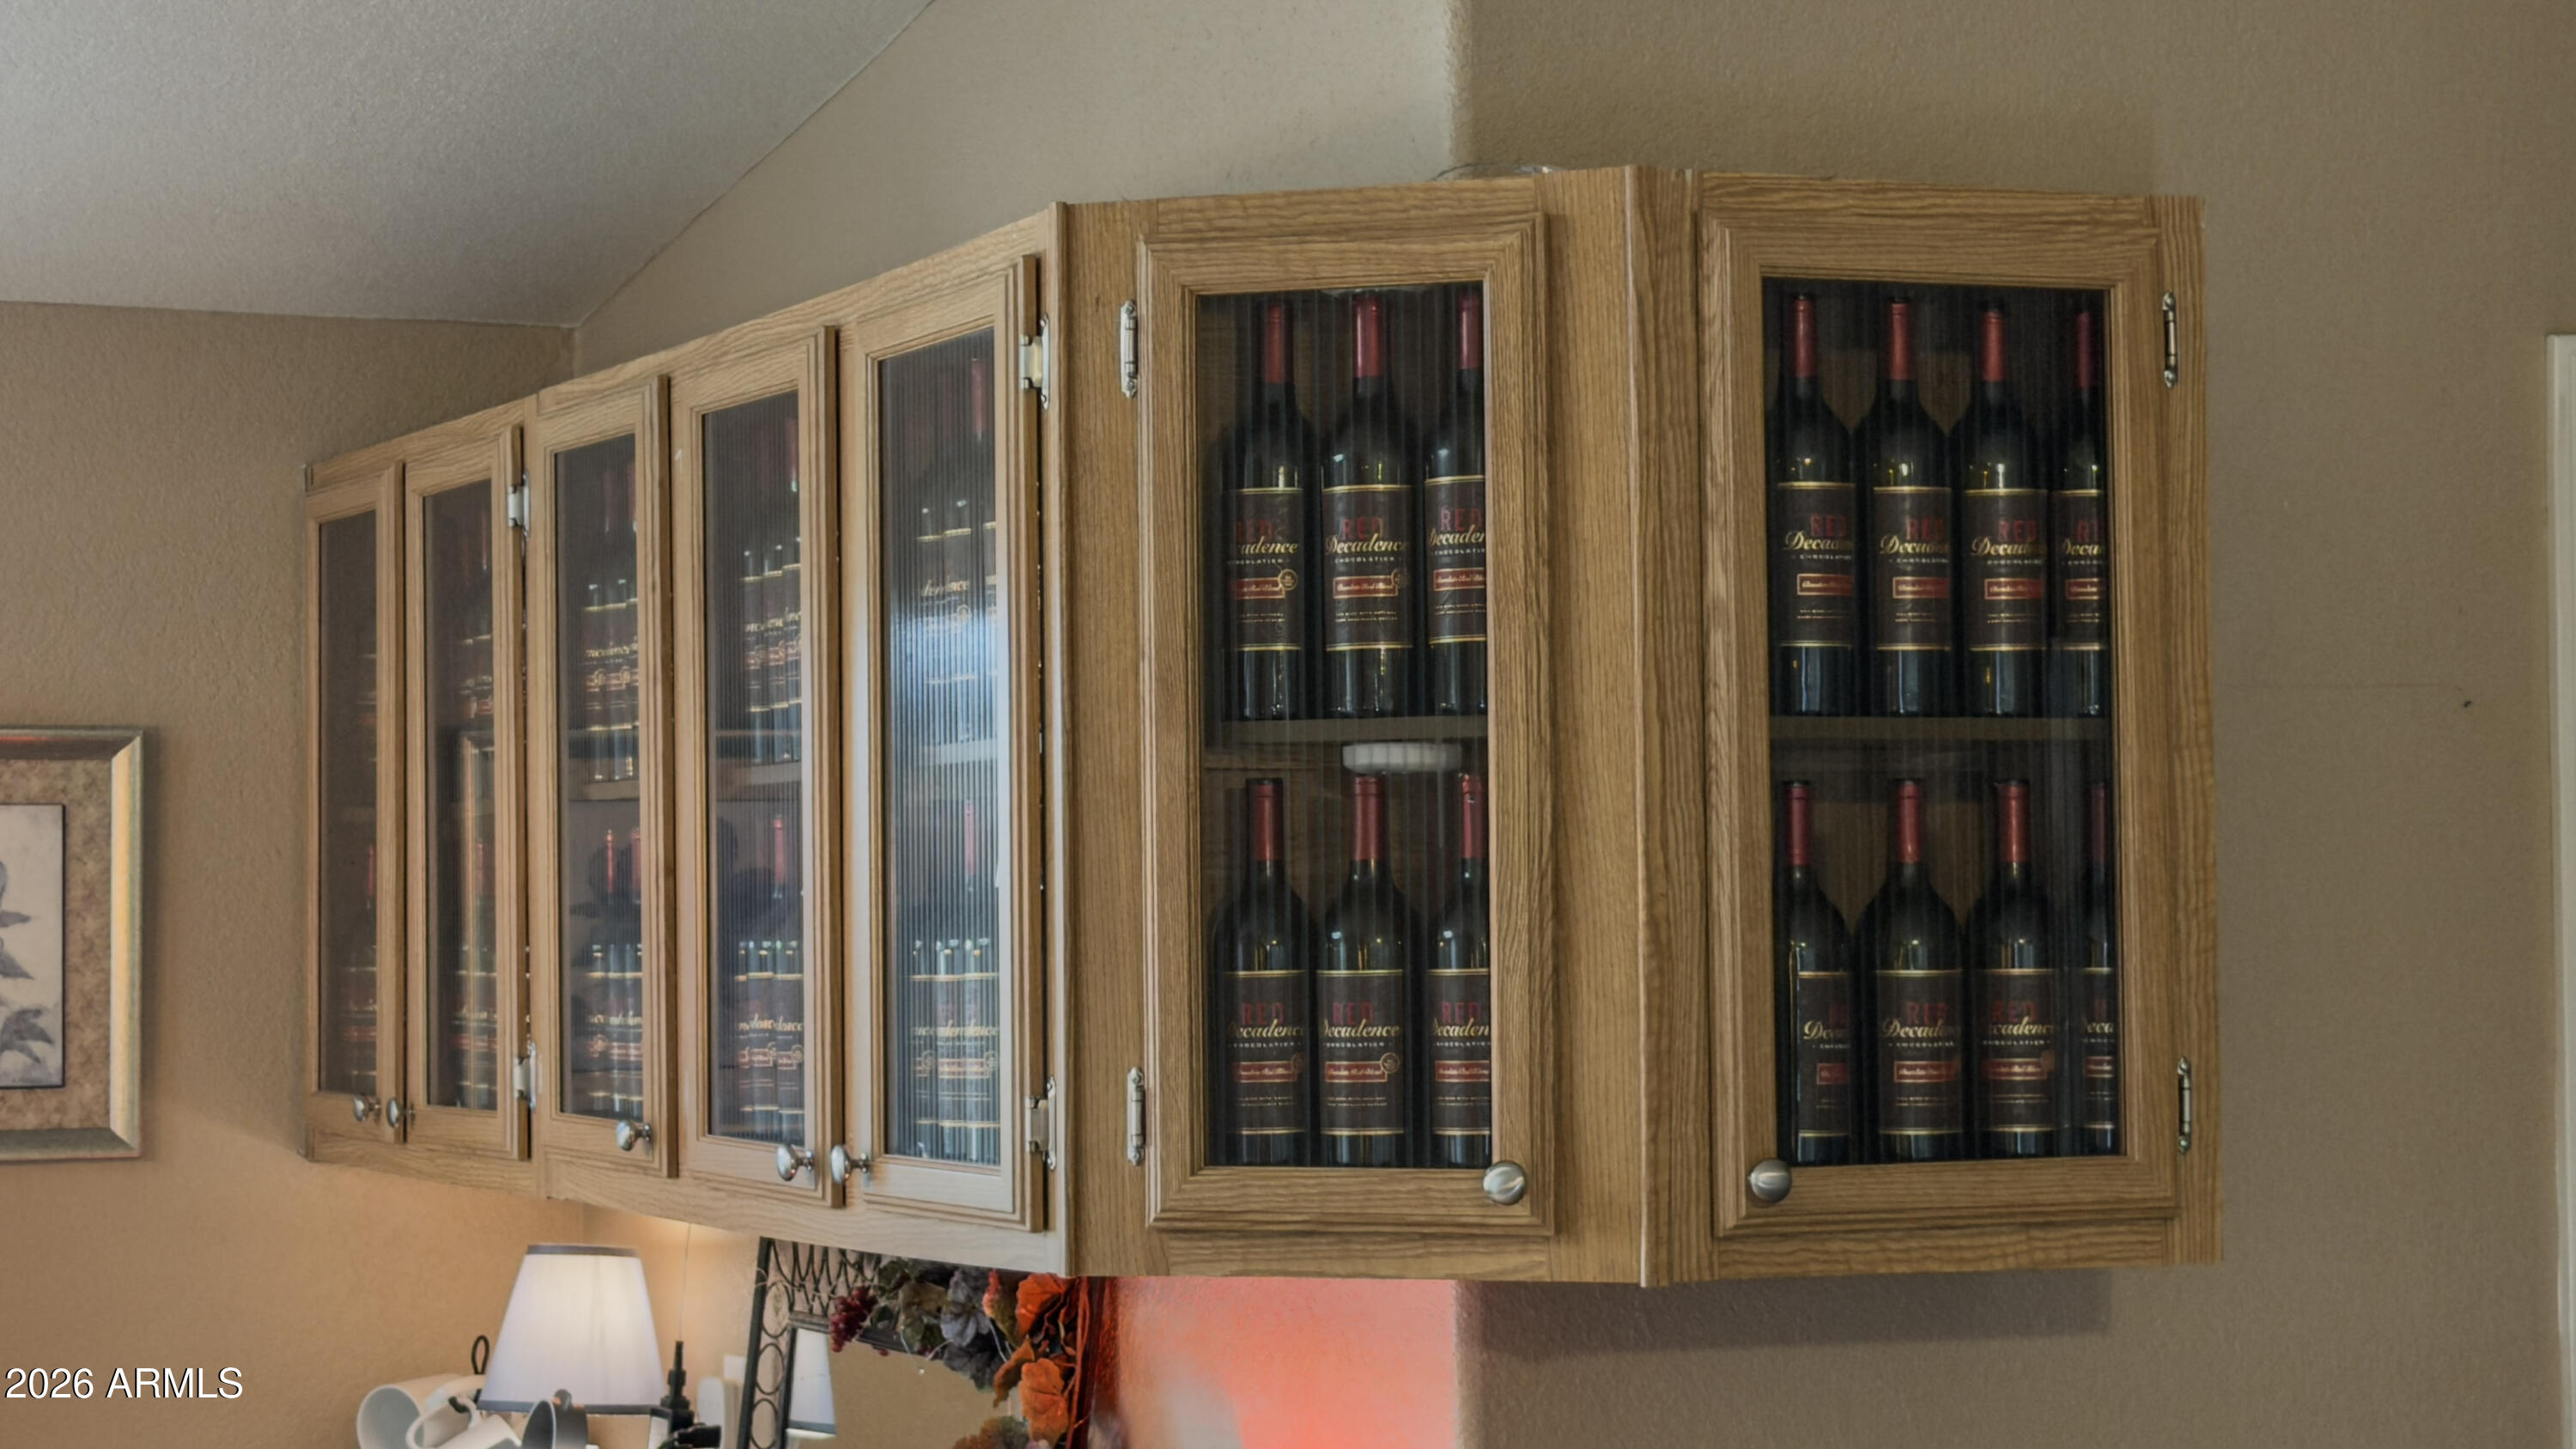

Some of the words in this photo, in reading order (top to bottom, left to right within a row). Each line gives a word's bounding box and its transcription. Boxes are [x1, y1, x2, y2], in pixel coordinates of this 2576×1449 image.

[1341, 516, 1385, 541] RED
[1241, 1002, 1285, 1024] RED
[1332, 1002, 1374, 1025] RED
[1991, 999, 2037, 1023] RED
